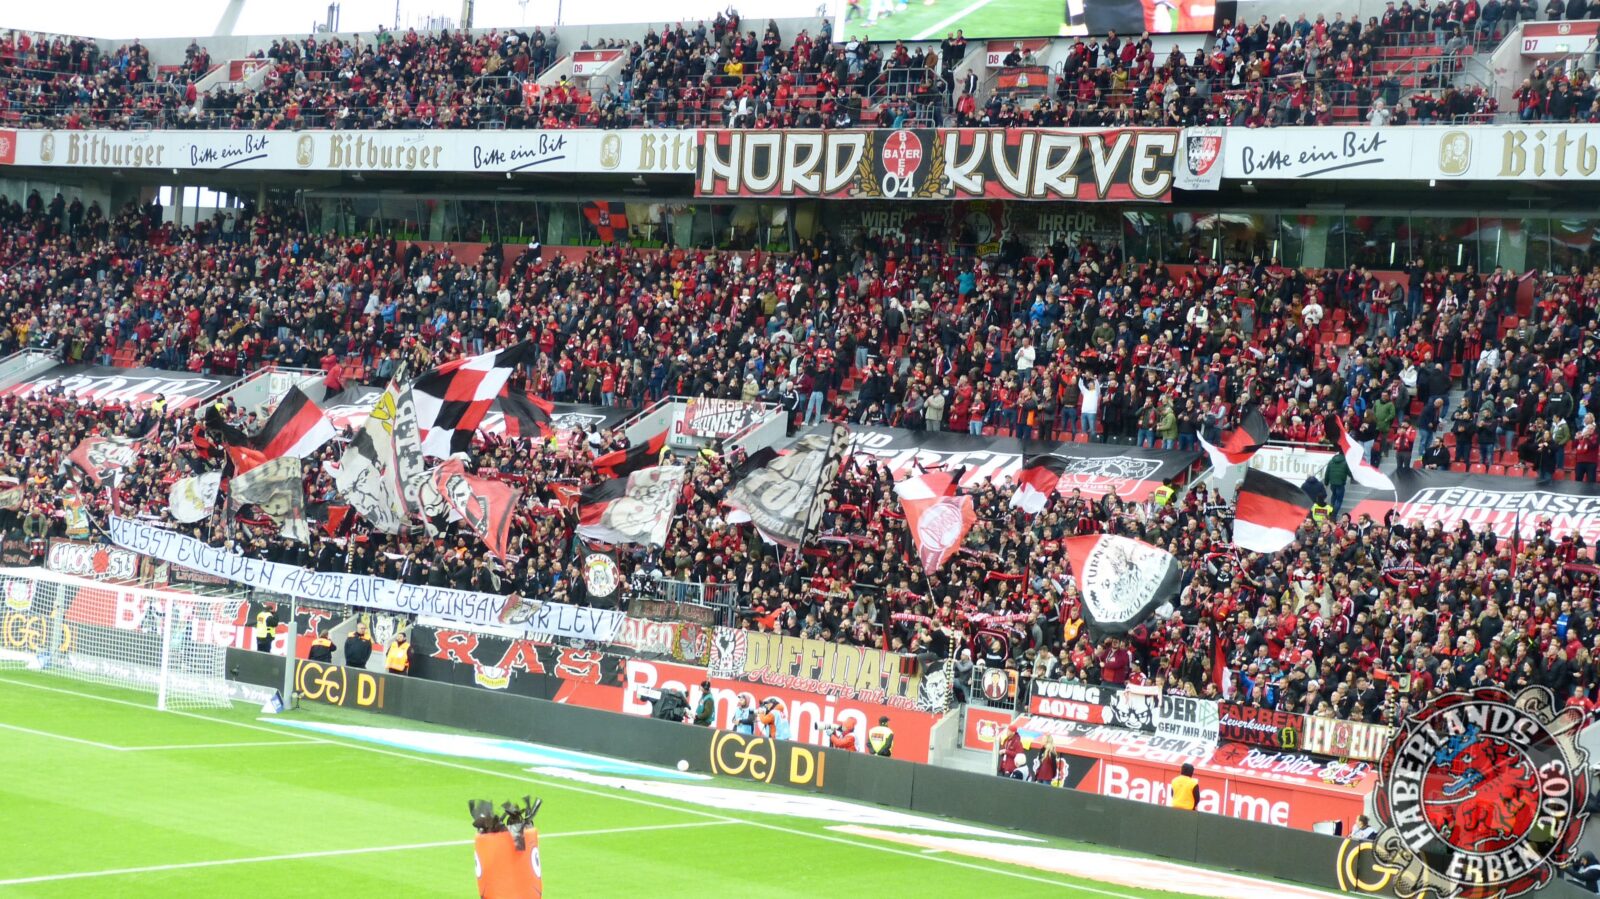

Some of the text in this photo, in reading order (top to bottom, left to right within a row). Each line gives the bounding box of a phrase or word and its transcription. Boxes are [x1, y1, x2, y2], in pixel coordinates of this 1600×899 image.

[1524, 39, 1538, 51] D7
[574, 64, 583, 73] D9
[66, 133, 164, 167] Bitburger
[190, 134, 269, 166] Bitte ein Bit
[327, 133, 443, 170] Bitburger
[473, 133, 567, 169] Bitte ein Bit
[884, 149, 920, 158] BAYER
[1242, 131, 1387, 175] Bitte ein Bit
[699, 130, 1178, 199] NORD KURVE
[882, 171, 915, 198] 04
[110, 517, 176, 558] REISST
[230, 556, 275, 586] DEN
[281, 568, 341, 600] ARSCH
[557, 605, 604, 634] LEV
[748, 664, 855, 699] Ausgesperrte
[858, 687, 885, 704] mit
[1036, 679, 1100, 702] YOUNG
[1159, 695, 1197, 723] DER
[1218, 702, 1304, 730] FARBEN
[1219, 713, 1278, 733] Leverkusen
[1158, 721, 1218, 743] GEHT MIR AUF
[1303, 716, 1336, 754] LEV
[1239, 748, 1272, 769] Red
